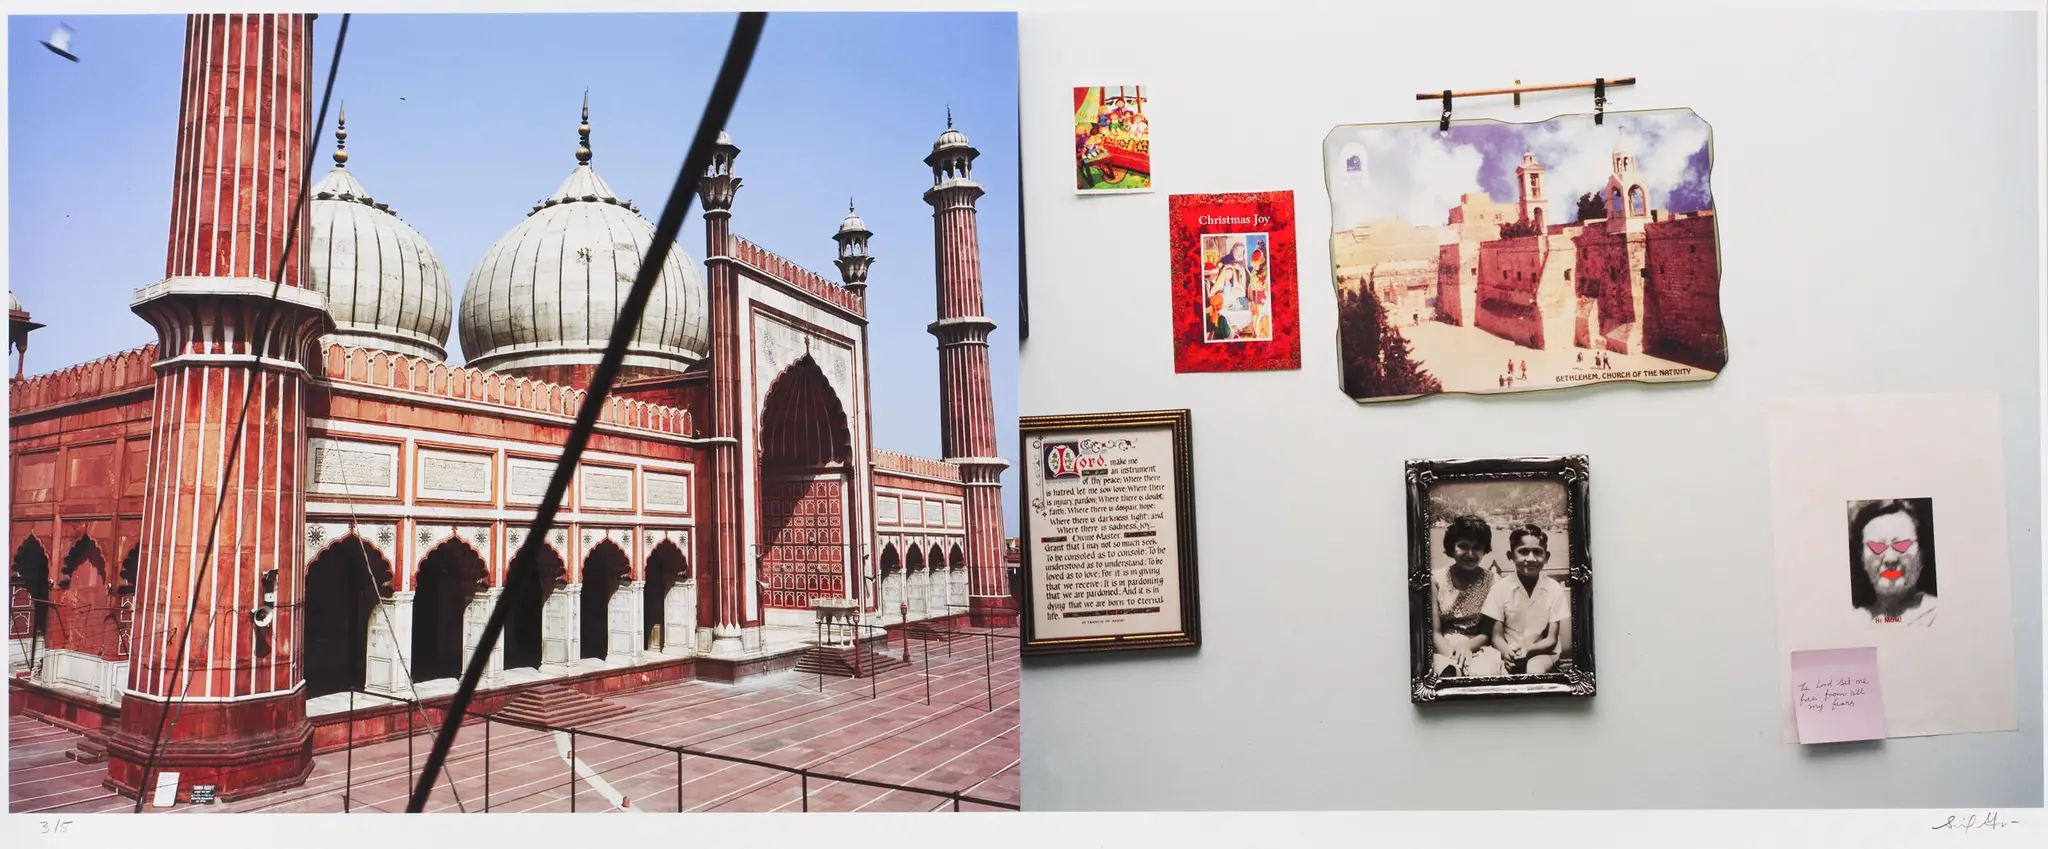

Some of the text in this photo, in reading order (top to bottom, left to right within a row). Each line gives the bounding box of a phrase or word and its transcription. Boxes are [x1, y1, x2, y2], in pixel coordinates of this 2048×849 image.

[1198, 213, 1270, 226] Christmas Joy
[1602, 372, 1630, 380] CHURCH
[1660, 368, 1692, 376] NATIVITY
[1110, 458, 1126, 466] make
[1120, 465, 1156, 474] instrument
[1082, 477, 1090, 485] of
[1144, 474, 1160, 482] there
[1076, 487, 1086, 495] let
[1128, 484, 1147, 492] Where
[1120, 494, 1137, 502] there
[1072, 516, 1088, 524] there
[1151, 511, 1164, 519] and
[1057, 526, 1078, 534] Where
[1044, 544, 1064, 552] Grant
[1046, 554, 1054, 562] To
[1064, 551, 1095, 561] consoled
[1108, 550, 1115, 558] to
[1148, 546, 1156, 554] To
[1157, 546, 1166, 554] be
[1045, 562, 1085, 571] understood
[1156, 557, 1163, 565] be
[1046, 572, 1064, 581] loved
[1102, 569, 1112, 577] For
[1138, 568, 1160, 577] giving
[1104, 579, 1109, 588] It
[1127, 577, 1164, 588] pardoning
[1046, 592, 1061, 600] that
[1122, 587, 1136, 595] And
[1047, 602, 1065, 611] dying
[1137, 596, 1164, 604] eternal
[1800, 688, 1865, 706] free from all
[1808, 699, 1855, 713] my fears
[40, 819, 73, 834] 3/5
